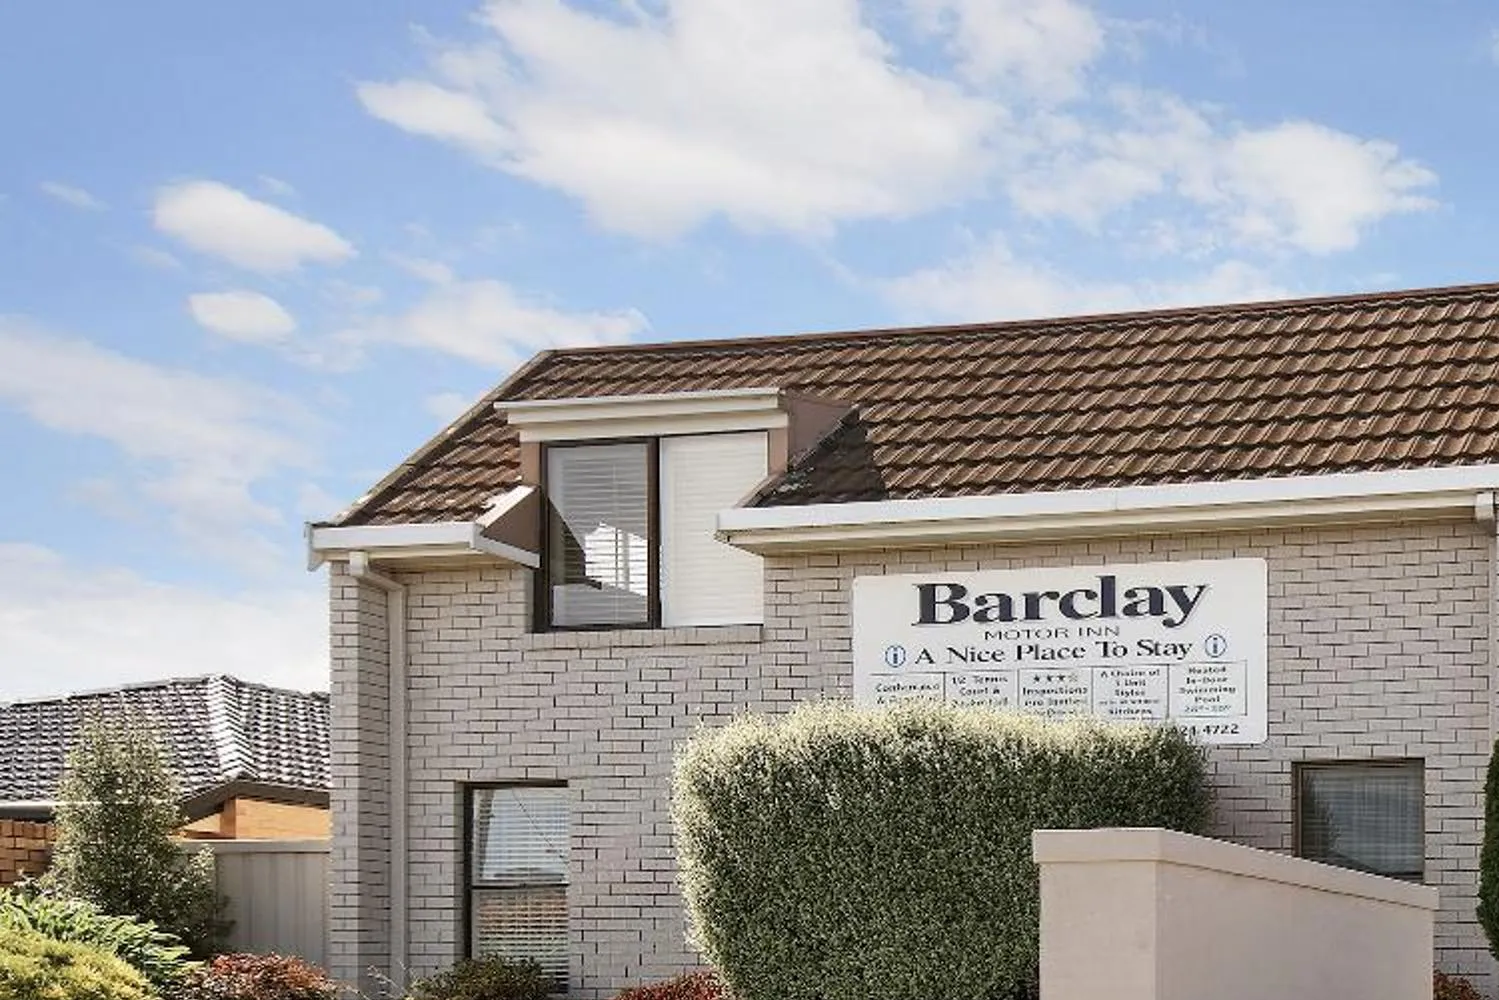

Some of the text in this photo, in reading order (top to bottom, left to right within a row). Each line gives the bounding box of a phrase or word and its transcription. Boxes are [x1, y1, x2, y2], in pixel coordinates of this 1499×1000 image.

[911, 575, 1211, 628] Barclay
[985, 625, 1120, 640] MOTOR INN
[915, 637, 1193, 664] A Nice Place To Stay
[1203, 724, 1240, 735] 4722
